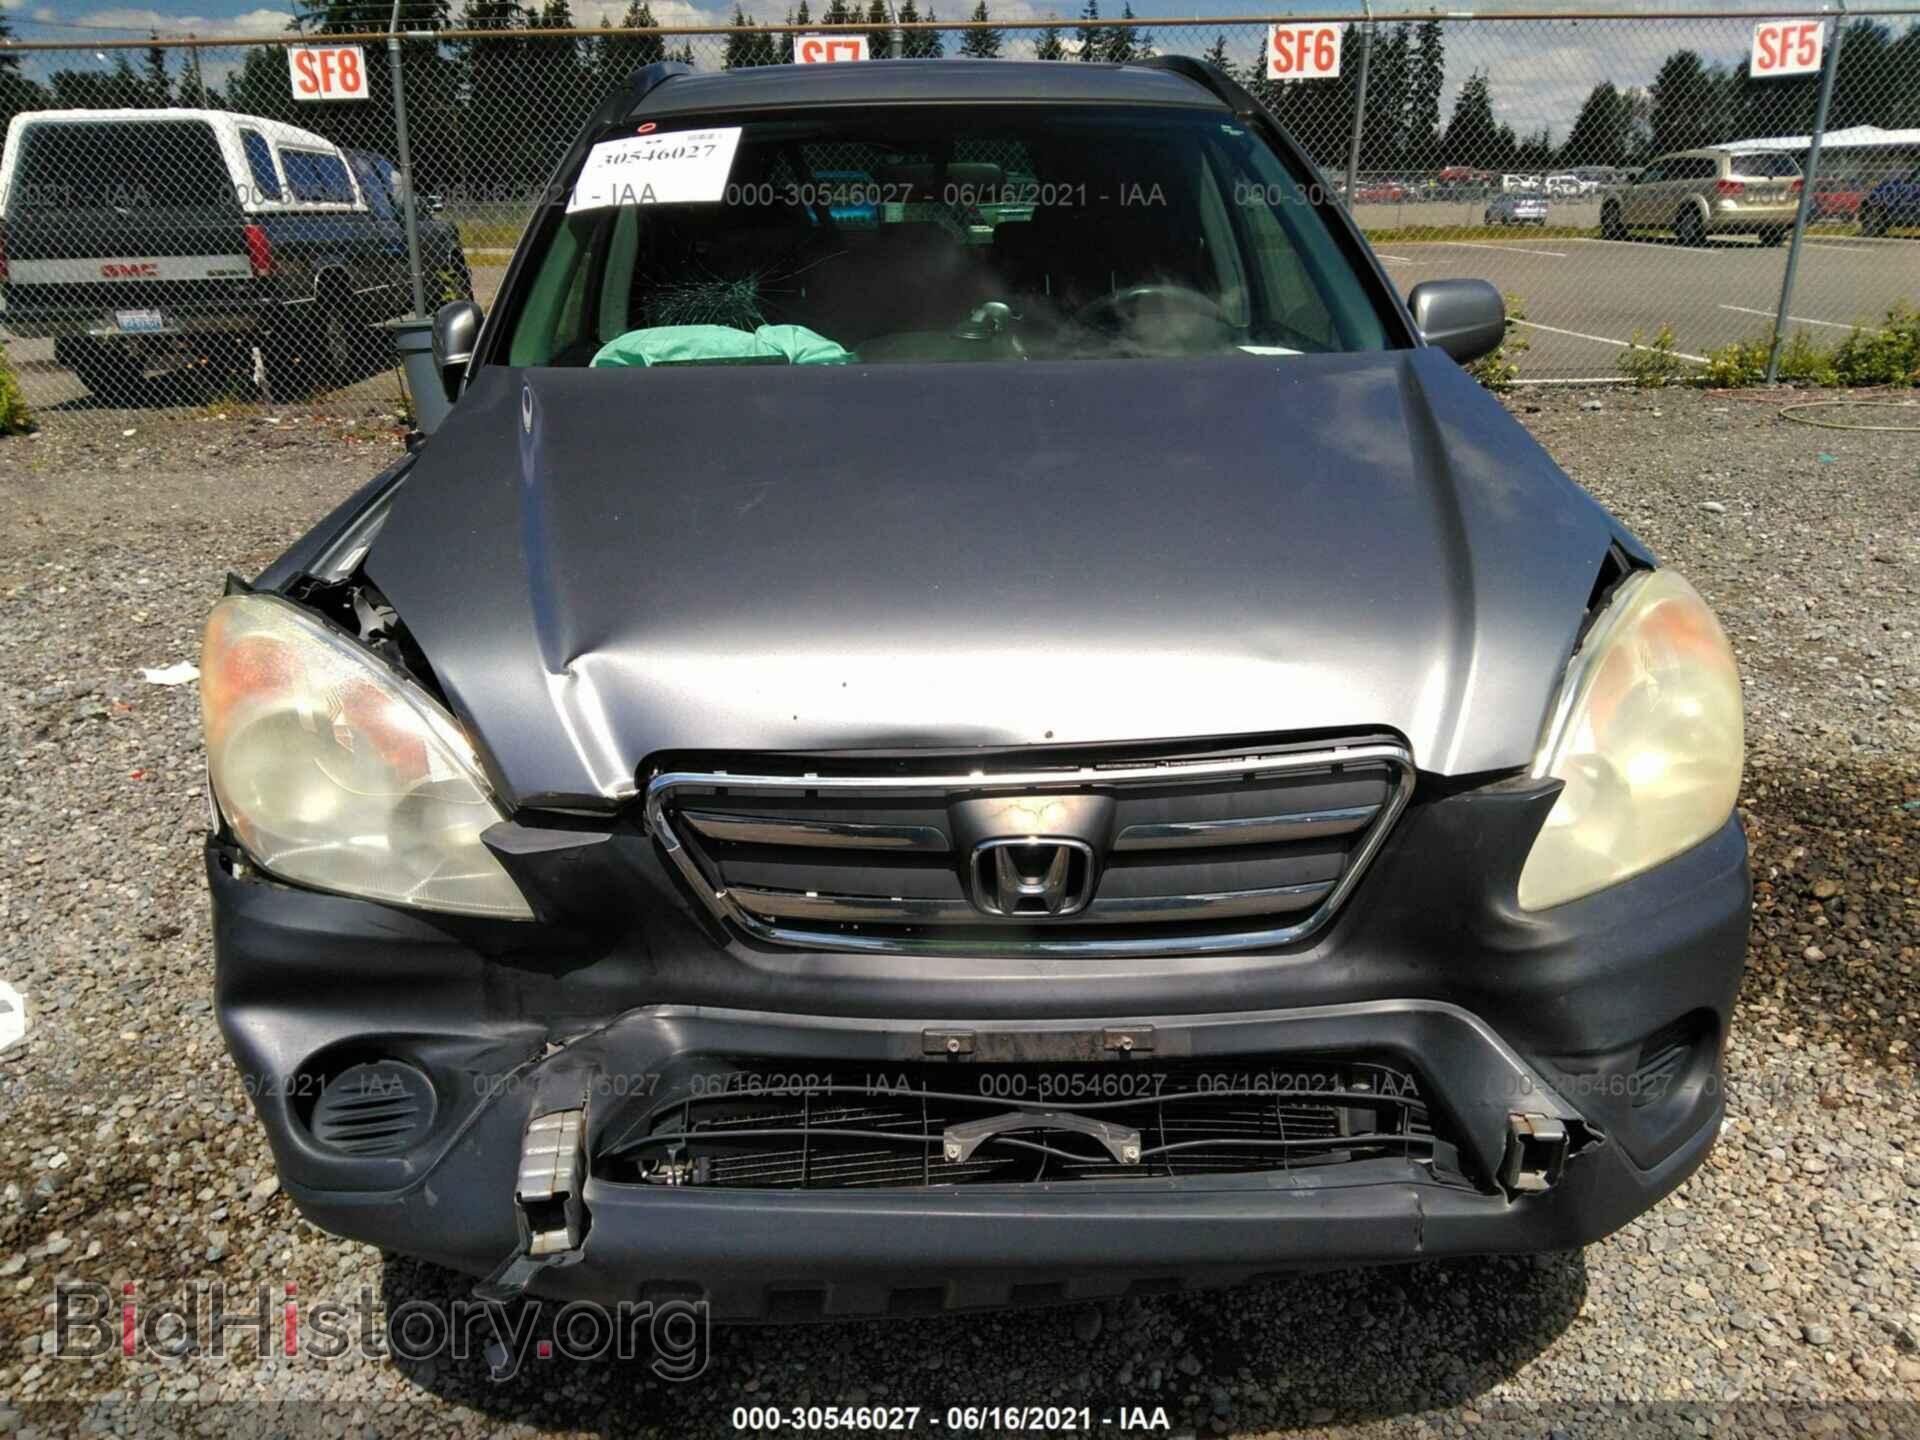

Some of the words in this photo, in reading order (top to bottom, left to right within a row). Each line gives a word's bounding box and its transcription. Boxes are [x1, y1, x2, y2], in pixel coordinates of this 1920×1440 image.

[1273, 29, 1335, 73] SF6
[1758, 24, 1819, 69] SF5
[295, 48, 361, 94] SF8
